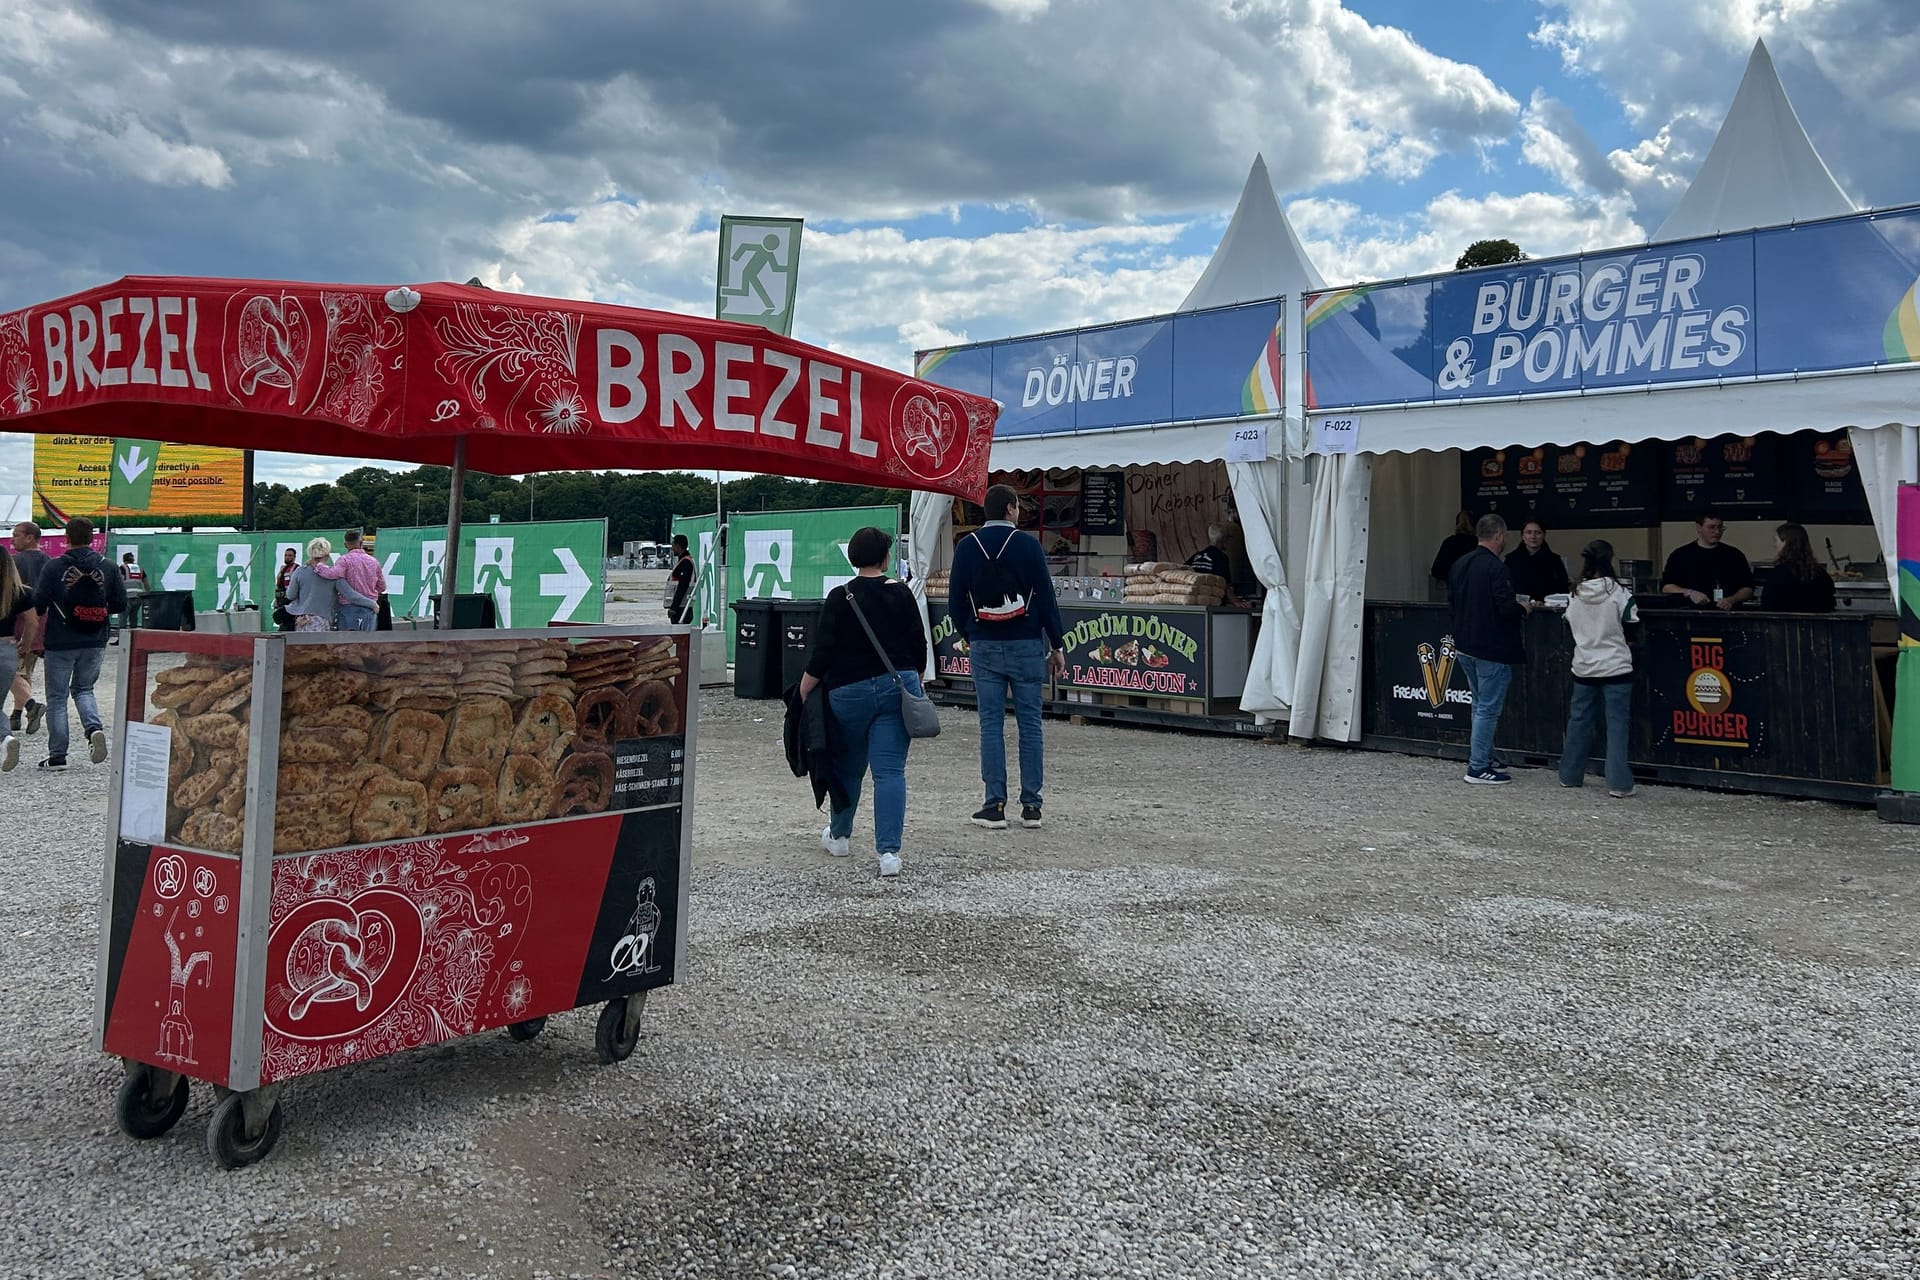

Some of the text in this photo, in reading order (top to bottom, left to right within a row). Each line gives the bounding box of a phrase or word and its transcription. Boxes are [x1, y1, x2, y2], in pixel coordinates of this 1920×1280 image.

[1472, 253, 1705, 334] BURGER
[43, 297, 212, 397] BREZEL
[1438, 305, 1750, 390] & POMMES
[597, 329, 879, 458] BREZEL
[1022, 353, 1139, 408] DÖNER
[1234, 430, 1258, 441] F-023
[1324, 420, 1352, 431] F-022
[52, 436, 77, 445] direkt
[79, 437, 92, 445] vor
[94, 436, 107, 445] der
[77, 463, 106, 472] Access
[158, 463, 189, 473] directly
[191, 463, 200, 471] in
[51, 477, 72, 486] front
[74, 477, 83, 486] of
[85, 477, 98, 486] the
[172, 478, 186, 486] not
[1062, 612, 1198, 664] DÜRÜM DÖNER
[1690, 644, 1724, 670] BIG
[1072, 665, 1186, 694] LAHMACUN
[1392, 684, 1473, 704] FREAKY FRIES
[1672, 710, 1749, 739] BURGER
